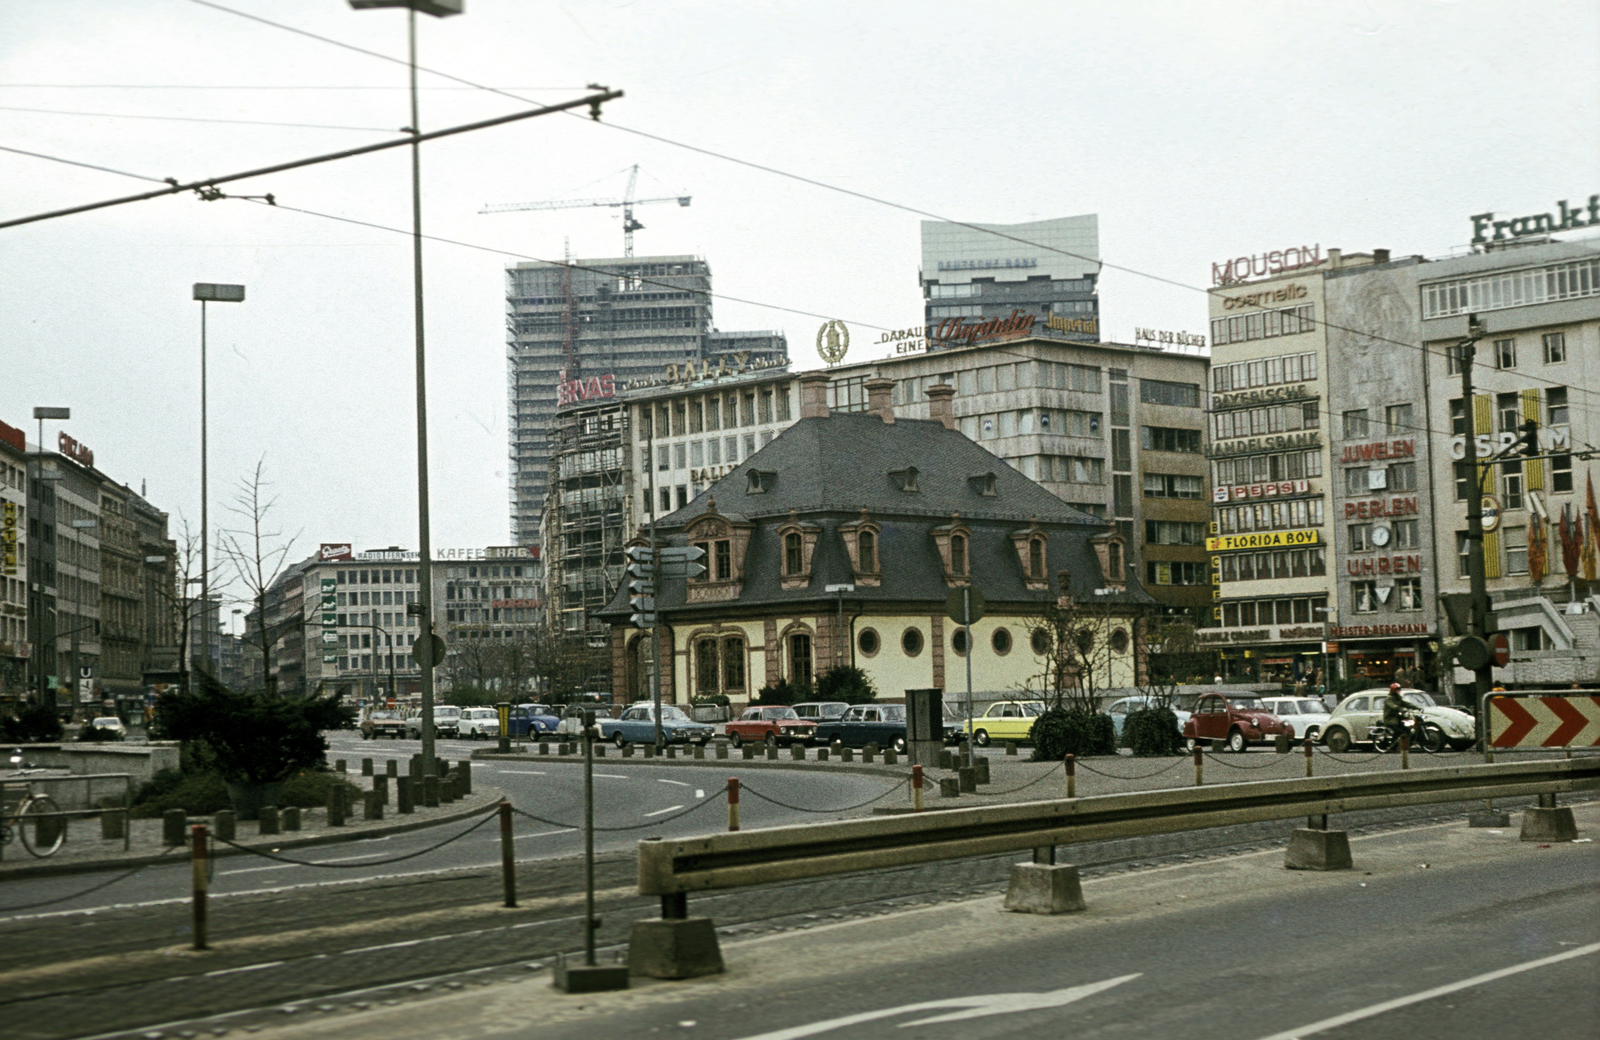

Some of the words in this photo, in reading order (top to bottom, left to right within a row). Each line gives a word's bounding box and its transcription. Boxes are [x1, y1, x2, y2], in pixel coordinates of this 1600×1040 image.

[938, 259, 999, 271] DEUTSCHE
[1005, 257, 1037, 268] BANK
[1212, 243, 1320, 284] MOUSON
[1223, 283, 1308, 310] cosmetic
[936, 309, 1036, 348] Dujardin
[1046, 310, 1097, 335] Imperial
[1135, 327, 1155, 341] HAUS
[1159, 331, 1173, 343] DER
[1176, 331, 1206, 346] BÜCHER
[896, 338, 932, 354] EINEN
[665, 351, 750, 383] BALLY
[1212, 385, 1306, 410] BAYERISCHE
[1204, 432, 1318, 458] HANDELSBANK
[1340, 439, 1415, 463] JUWELEN
[1449, 427, 1571, 460] OSRM
[1235, 482, 1305, 498] PEPSI
[1344, 497, 1418, 519] PERLEN
[4, 503, 16, 567] HOTEL
[1225, 535, 1281, 549] FLORIDA
[1286, 532, 1313, 544] BOY
[436, 548, 492, 559] KAFFEE
[496, 547, 527, 558] HAG
[1347, 555, 1420, 576] UHREN
[80, 667, 91, 678] U
